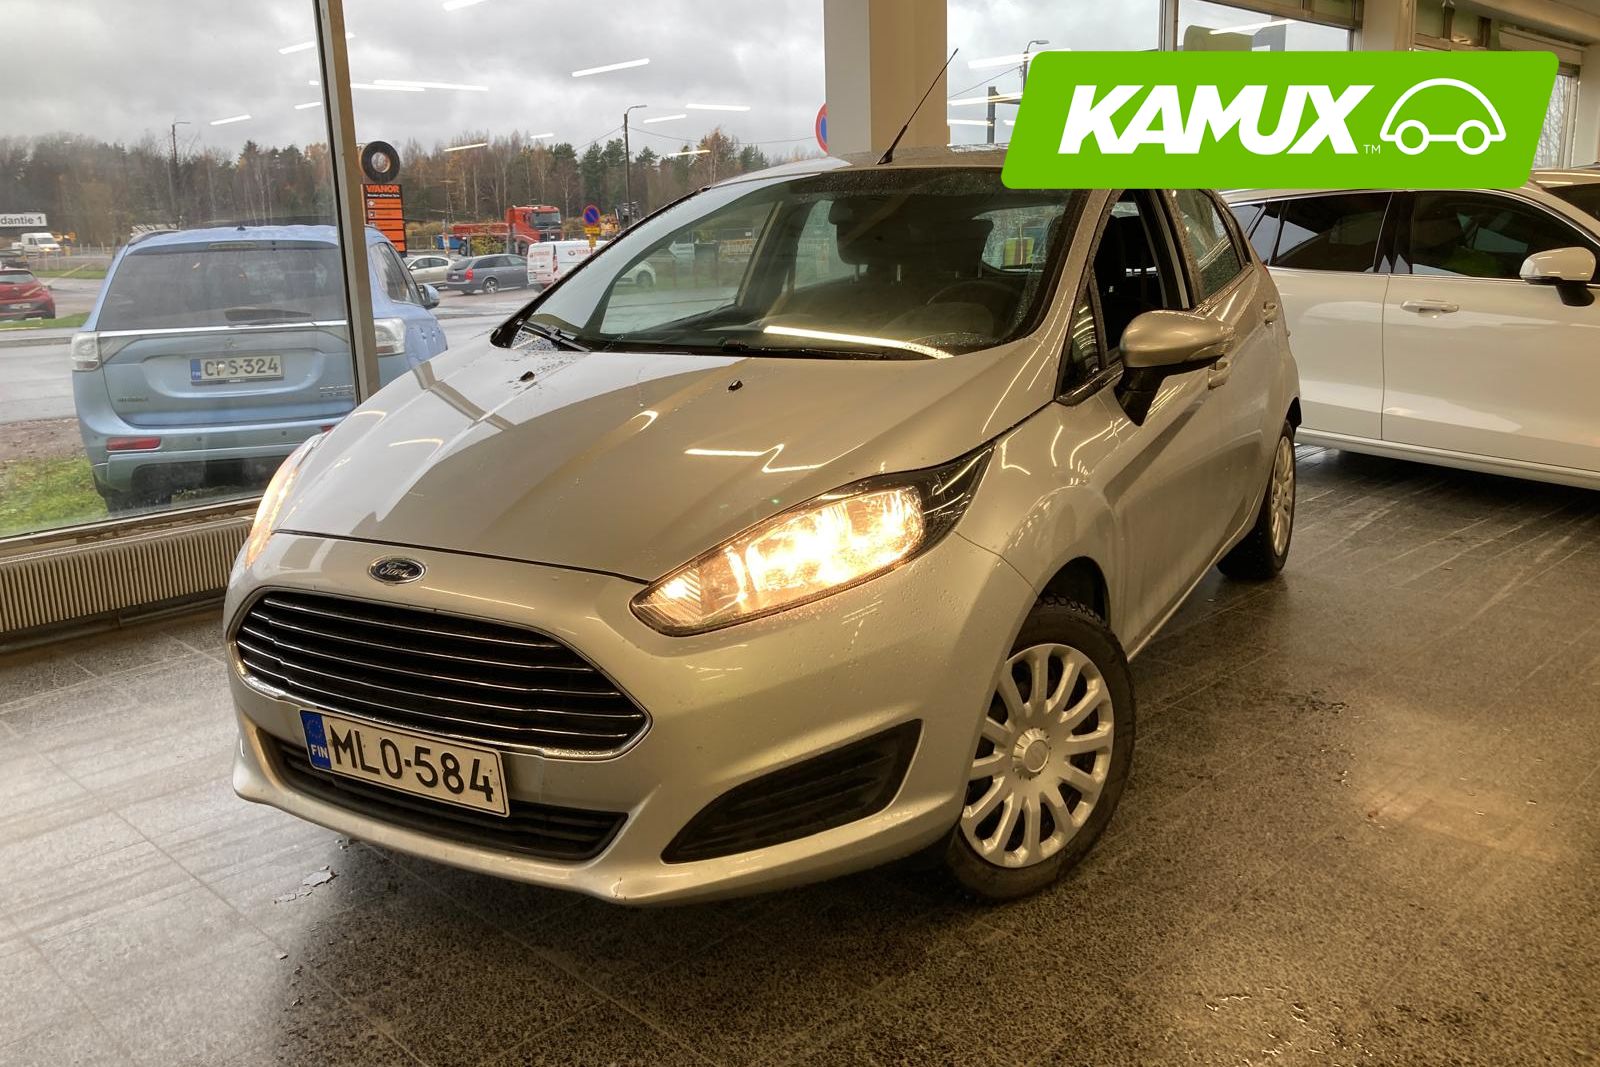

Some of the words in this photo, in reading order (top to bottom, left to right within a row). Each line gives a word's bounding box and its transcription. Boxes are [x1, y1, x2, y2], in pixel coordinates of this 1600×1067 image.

[37, 215, 42, 224] 1
[380, 562, 414, 578] Ford
[311, 743, 329, 759] FIN
[329, 724, 494, 803] MLO-584
